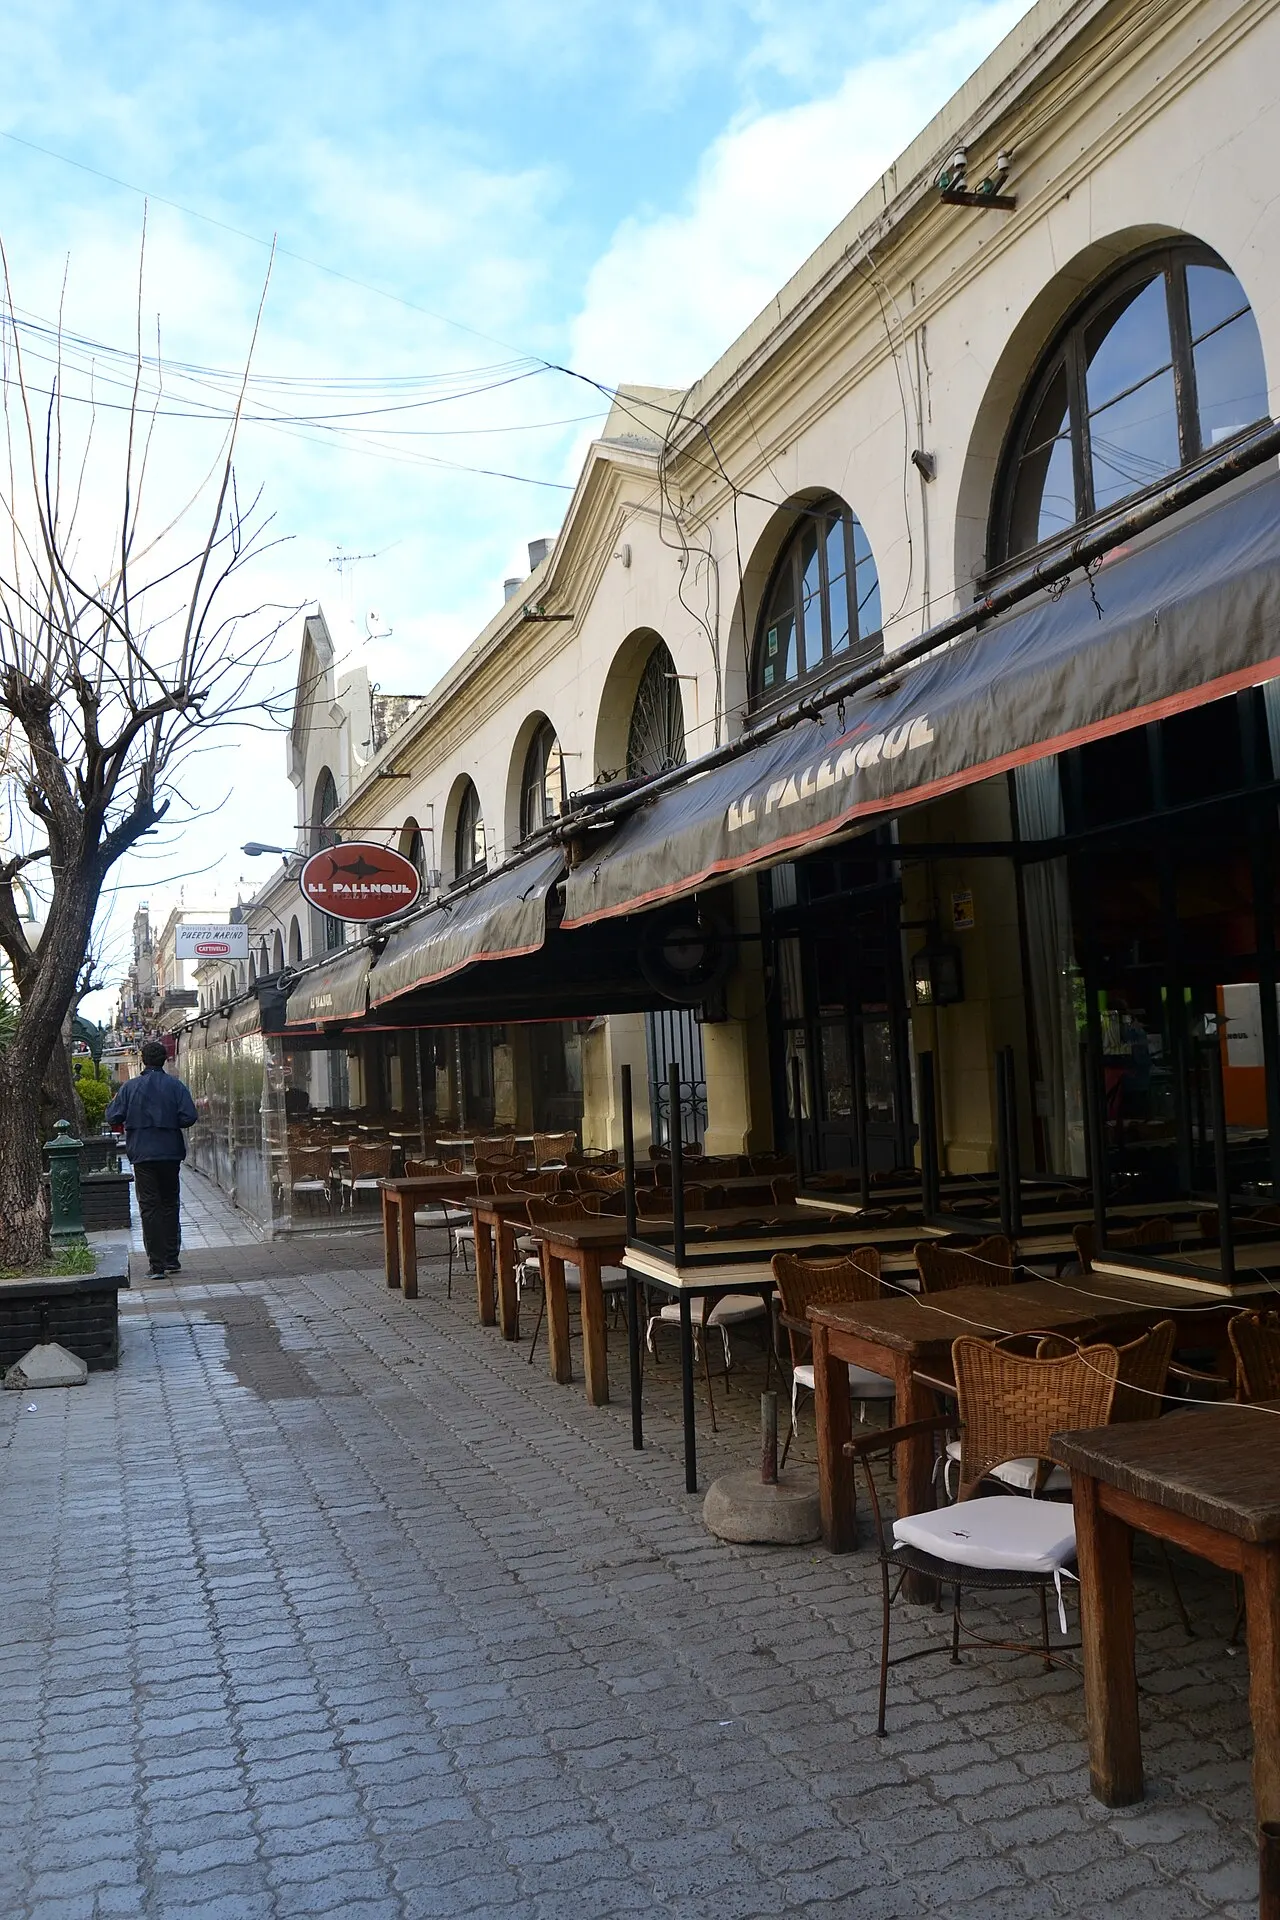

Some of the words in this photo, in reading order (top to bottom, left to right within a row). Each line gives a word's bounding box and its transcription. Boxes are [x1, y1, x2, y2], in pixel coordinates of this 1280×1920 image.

[728, 793, 756, 832] EL
[764, 712, 935, 815] PALENQUE
[308, 883, 327, 893] EL
[332, 883, 412, 894] PALENQUE
[181, 931, 212, 939] PUERTO
[213, 931, 244, 939] MARINO
